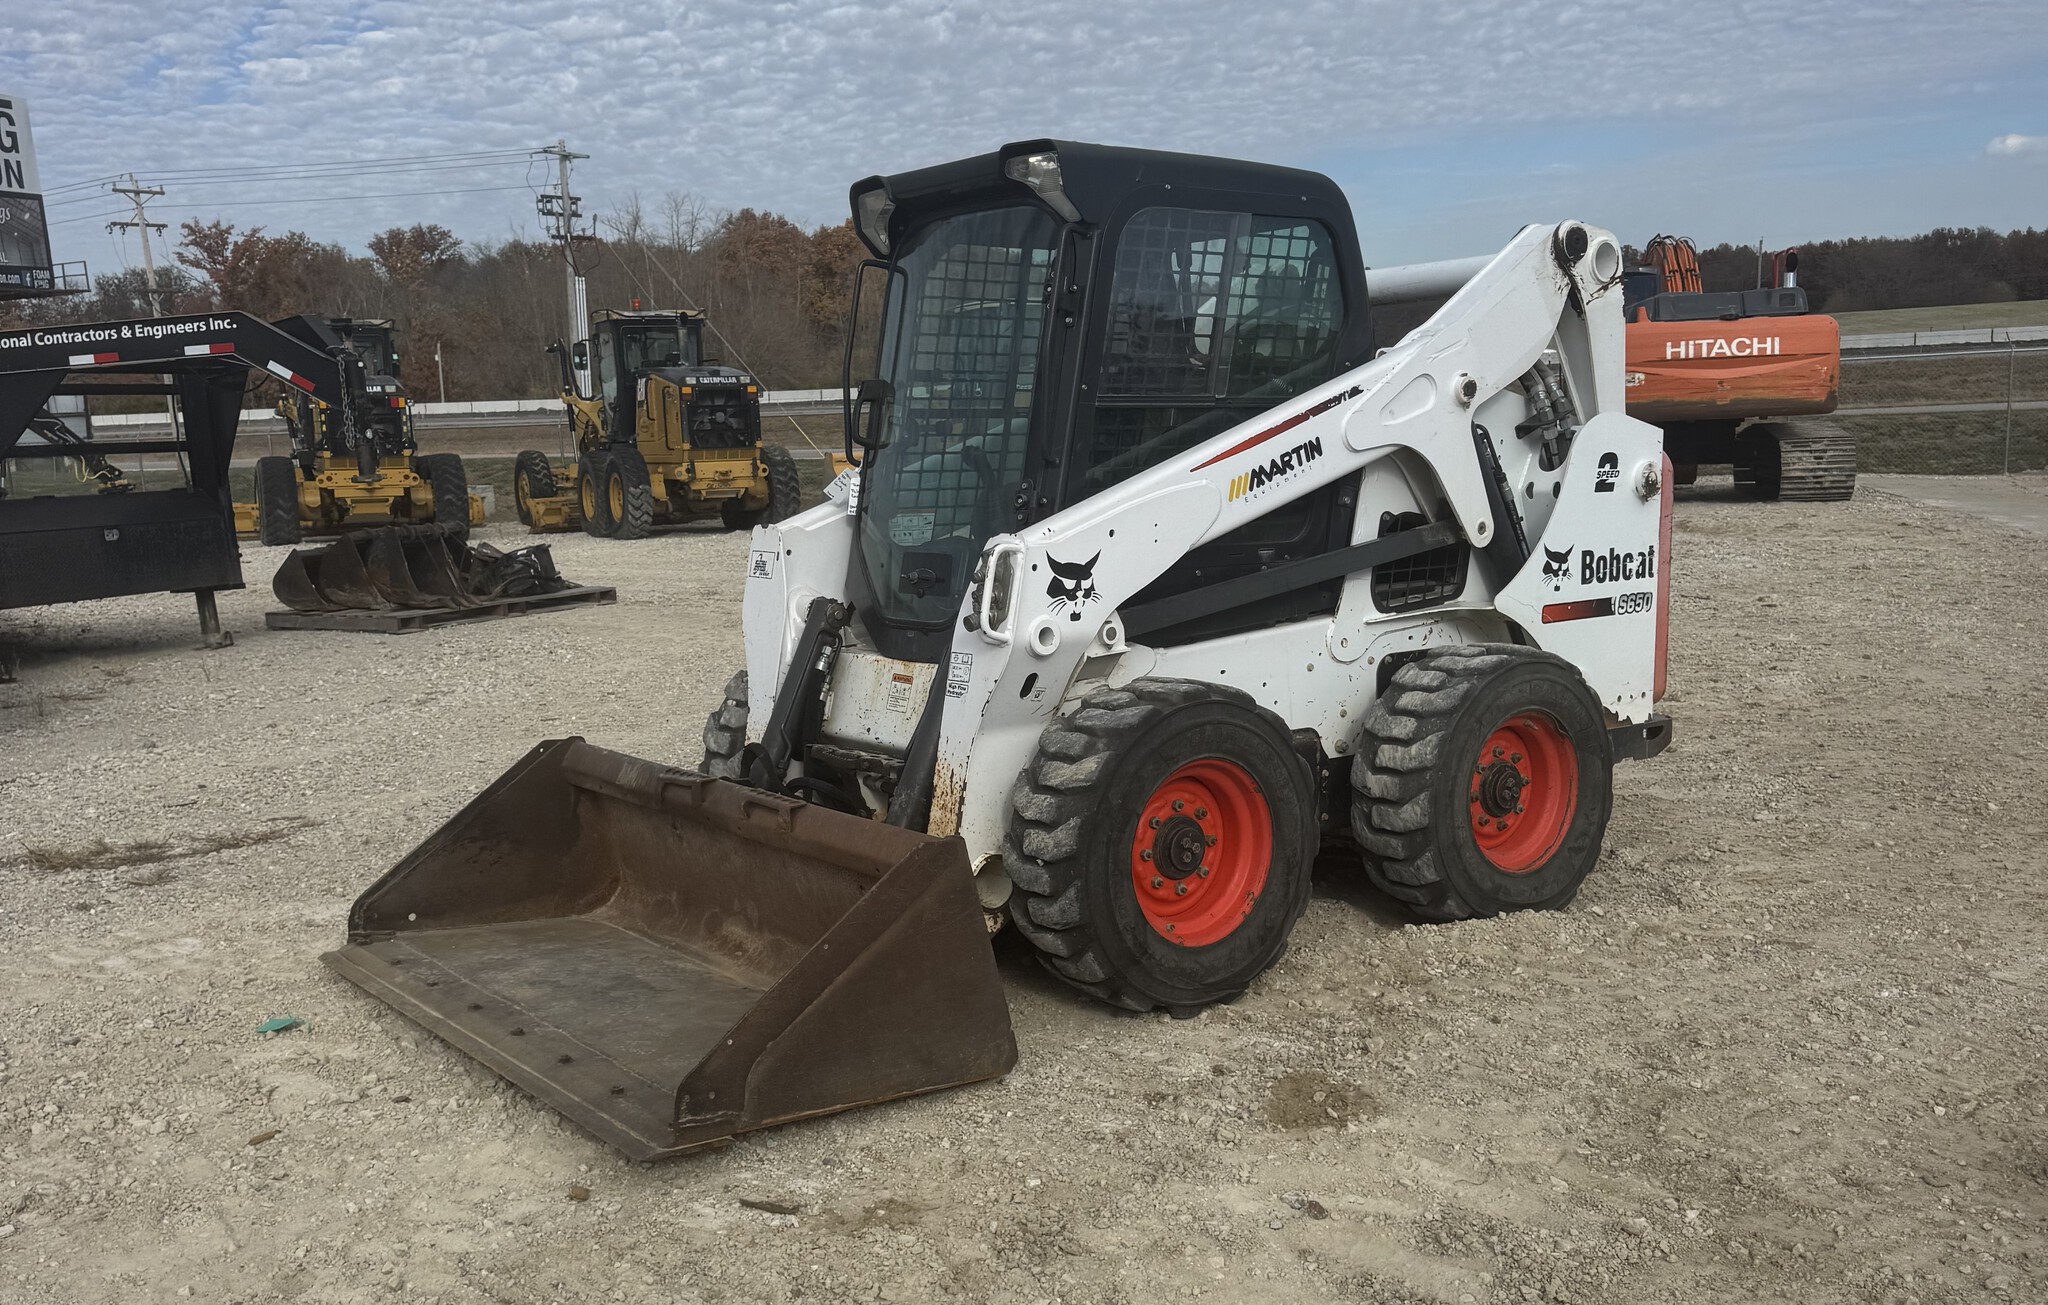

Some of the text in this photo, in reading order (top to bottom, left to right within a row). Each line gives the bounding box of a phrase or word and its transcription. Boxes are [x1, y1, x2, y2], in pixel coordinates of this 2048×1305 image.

[0, 158, 25, 189] N
[32, 269, 51, 280] FOAM
[0, 317, 238, 349] onal Contractors & Engineers Inc.
[1665, 337, 1780, 360] HITACHI
[699, 376, 738, 384] CATERPILLAR
[1248, 436, 1324, 492] MARTIN
[1596, 470, 1620, 479] SPEED
[1244, 465, 1314, 503] Equipment
[1581, 545, 1655, 585] Bobcat
[1617, 592, 1654, 615] S650
